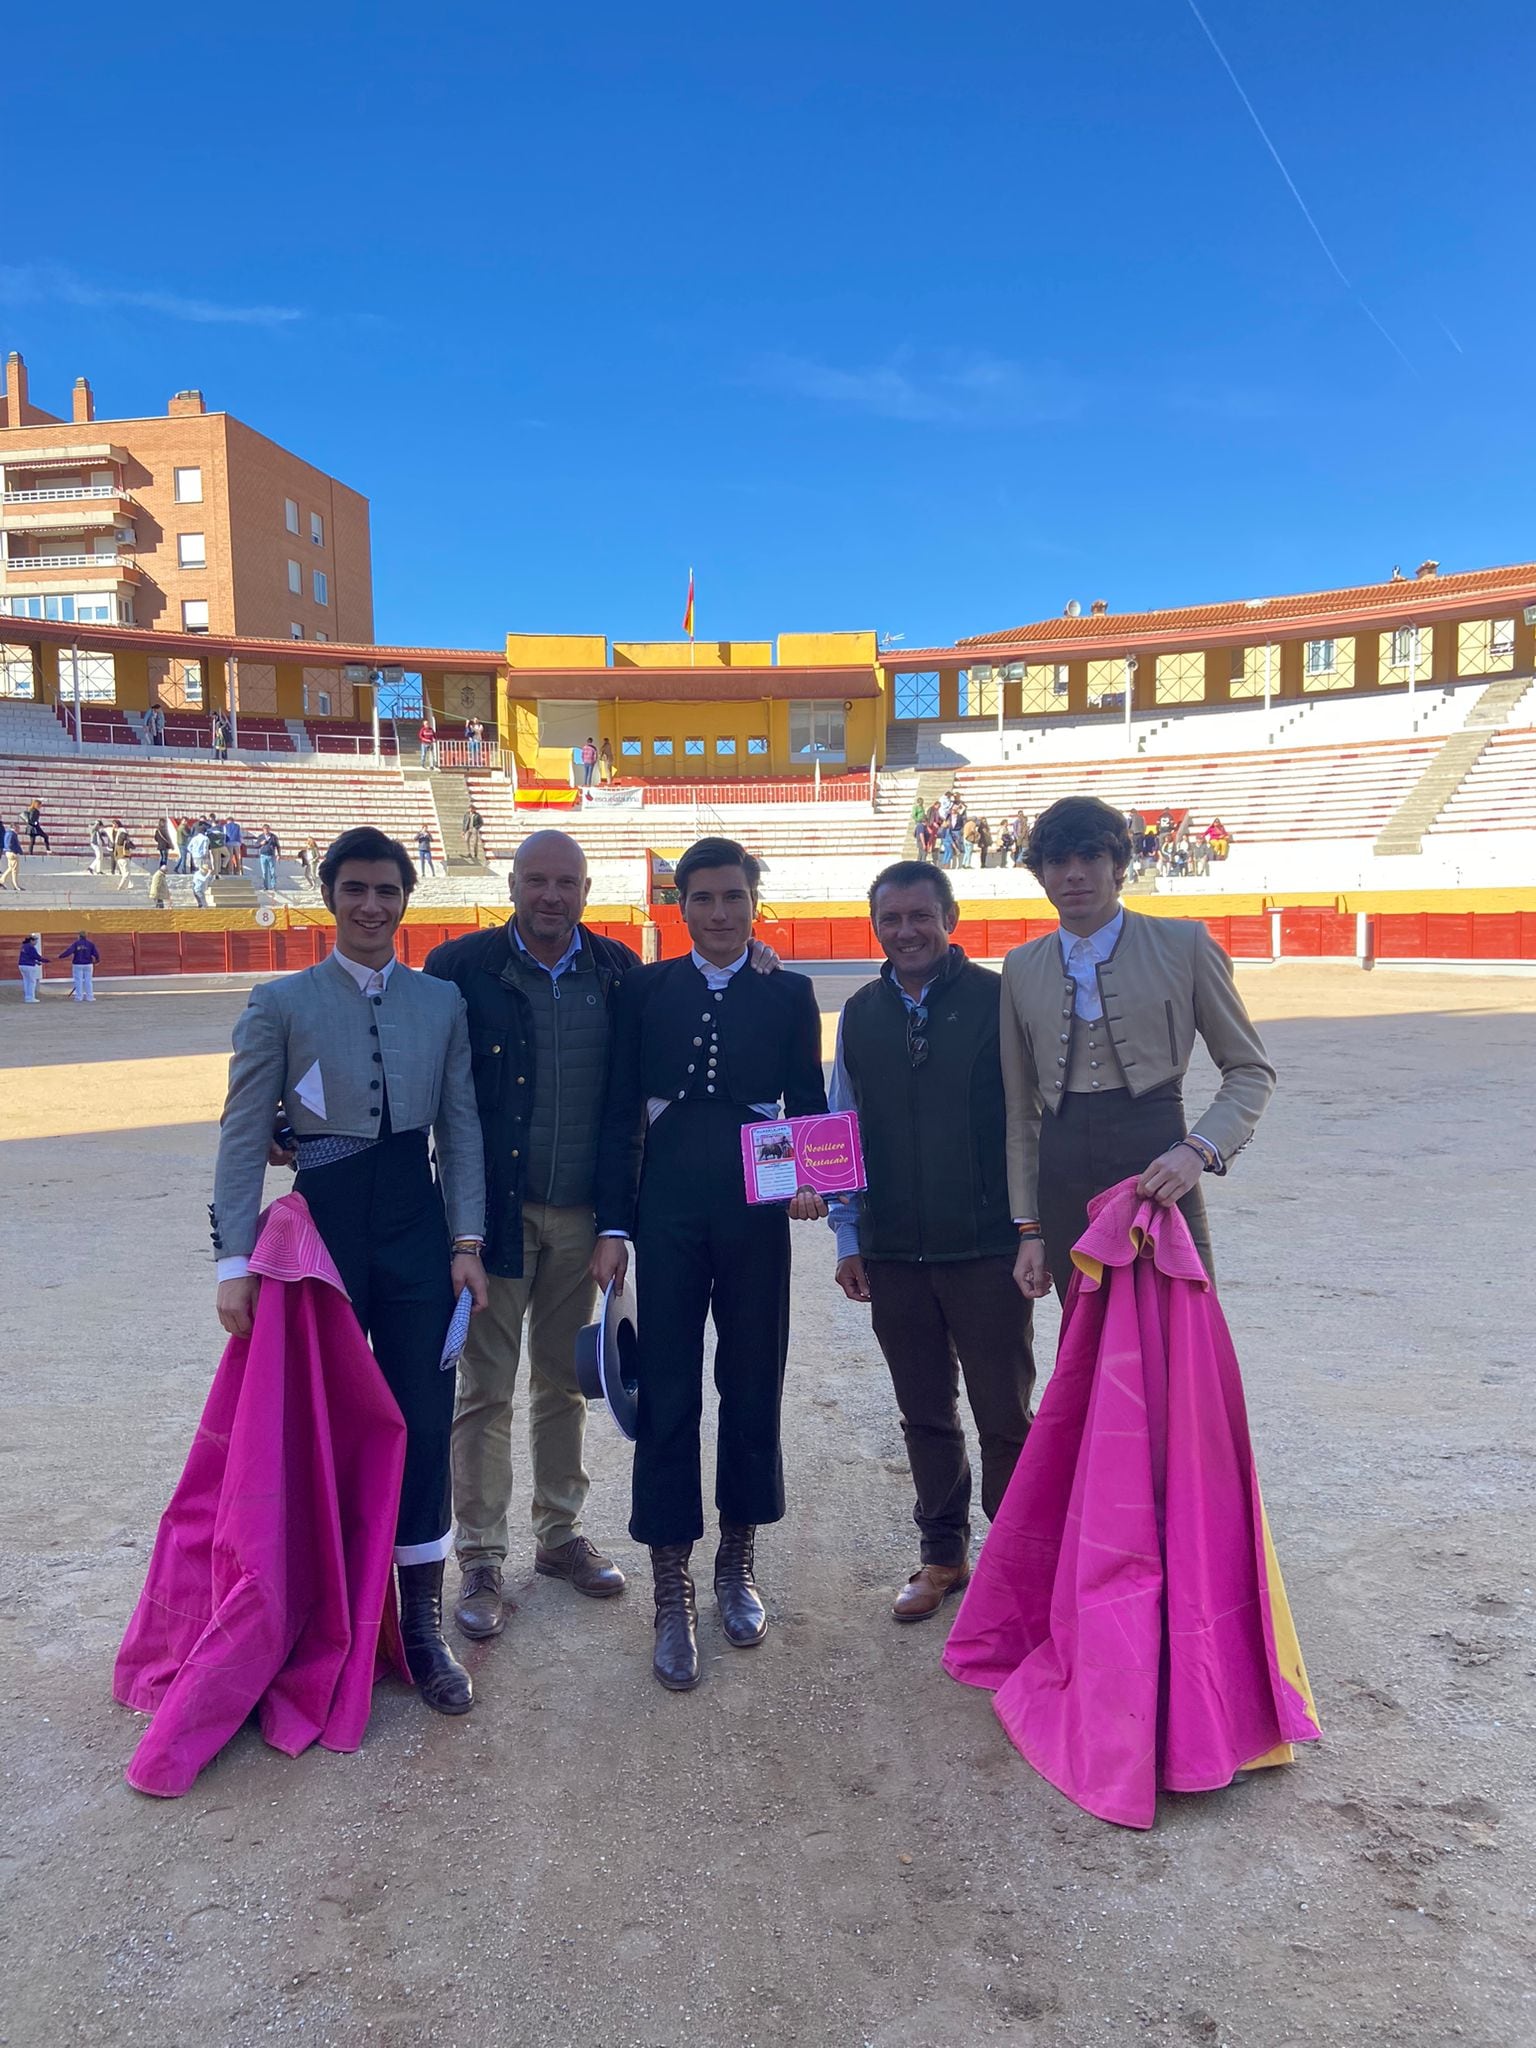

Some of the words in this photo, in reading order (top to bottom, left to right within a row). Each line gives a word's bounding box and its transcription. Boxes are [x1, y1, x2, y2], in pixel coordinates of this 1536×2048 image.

[263, 912, 269, 921] 8
[802, 1143, 845, 1155] Novillero
[804, 1155, 849, 1168] Destacado
